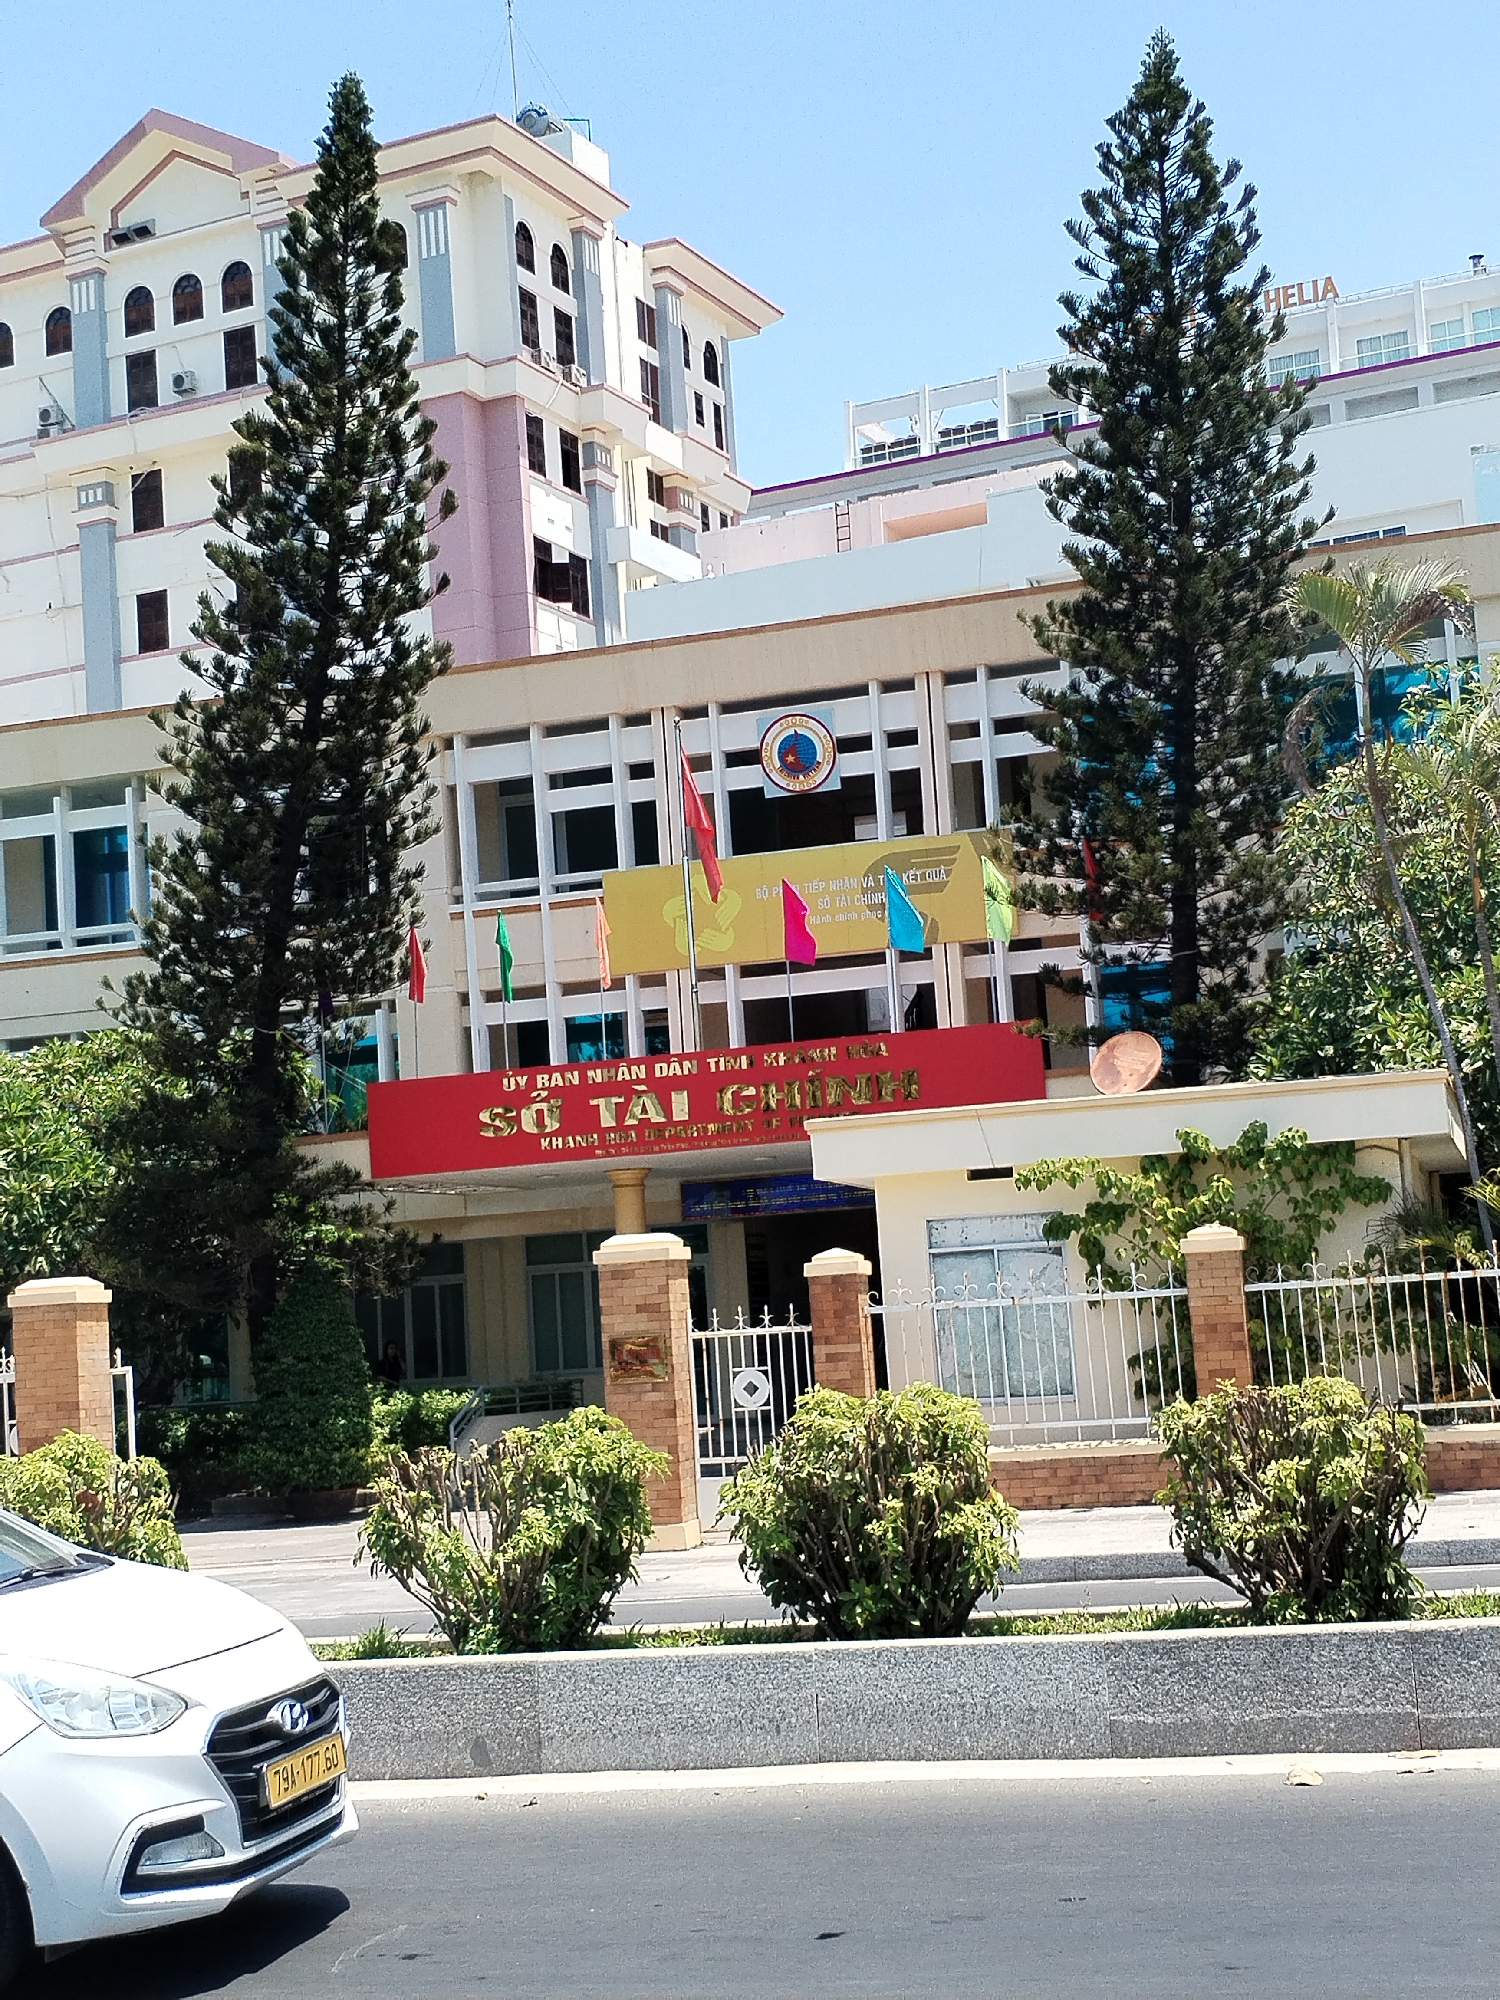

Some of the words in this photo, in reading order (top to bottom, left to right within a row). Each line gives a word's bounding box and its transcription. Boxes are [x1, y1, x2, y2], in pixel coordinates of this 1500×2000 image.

[1247, 275, 1339, 317] HELIA
[756, 885, 769, 901] BỘ
[804, 878, 826, 893] TIẾP
[830, 876, 858, 892] NHẬN
[862, 874, 874, 888] VÀ
[902, 868, 922, 884] KẾT
[926, 864, 947, 881] QUẢ
[818, 895, 831, 909] SỞ
[835, 893, 850, 907] TÀI
[855, 891, 886, 906] CHÍNH
[503, 1071, 528, 1092] ỦY
[536, 1070, 580, 1089] BAN
[587, 1063, 646, 1084] NHÂN
[655, 1057, 698, 1078] DÂN
[706, 1051, 754, 1072] TỈNH
[764, 1046, 838, 1067] KHÁNH
[848, 1039, 889, 1060] HÒA
[479, 1090, 562, 1137] SỞ
[589, 1084, 689, 1128] TÀI
[717, 1068, 919, 1116] CHÍNH
[540, 1133, 599, 1150] KHANH
[645, 1119, 754, 1141] DEPARTMENT
[764, 1116, 782, 1130] OF
[273, 1743, 339, 1796] 79A-177.60
